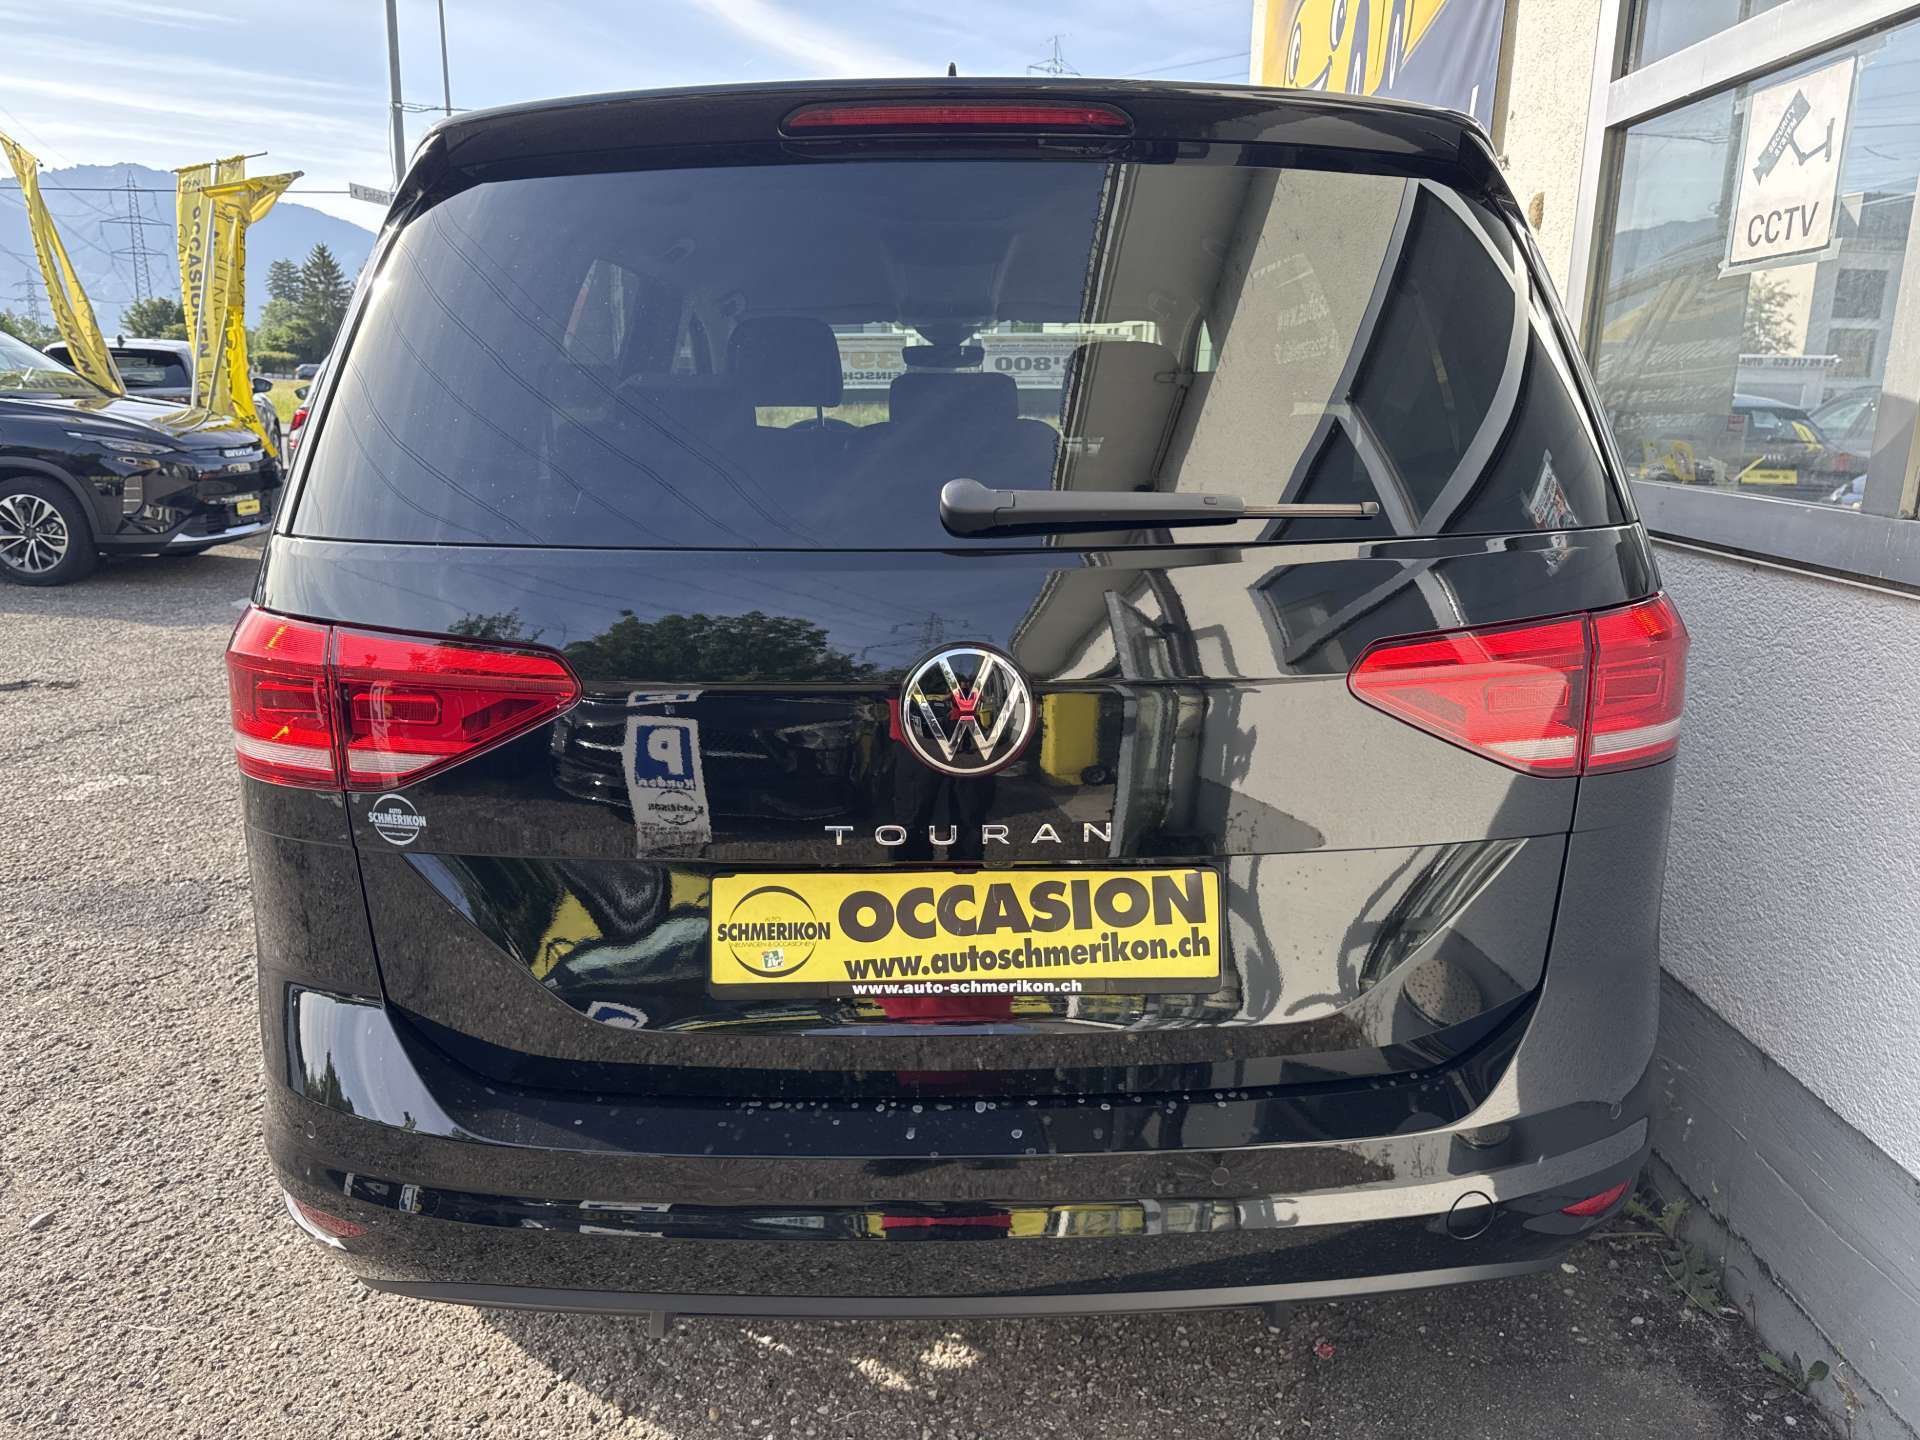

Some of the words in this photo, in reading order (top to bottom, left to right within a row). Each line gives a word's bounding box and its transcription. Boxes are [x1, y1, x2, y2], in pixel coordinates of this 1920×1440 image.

[1767, 107, 1797, 155] SECURITY
[1773, 117, 1799, 158] SYSTEM
[1747, 201, 1820, 248] CCTV
[368, 811, 427, 827] SCHMERIKON
[388, 807, 402, 815] AUTO
[824, 823, 1113, 846] TOURAN
[837, 872, 1207, 943] OCCASION
[717, 921, 831, 942] SCHMERIKON
[845, 924, 1211, 980] www.autoschmerikon.ch
[852, 979, 1082, 995] www.auto-schmerikon.ch
